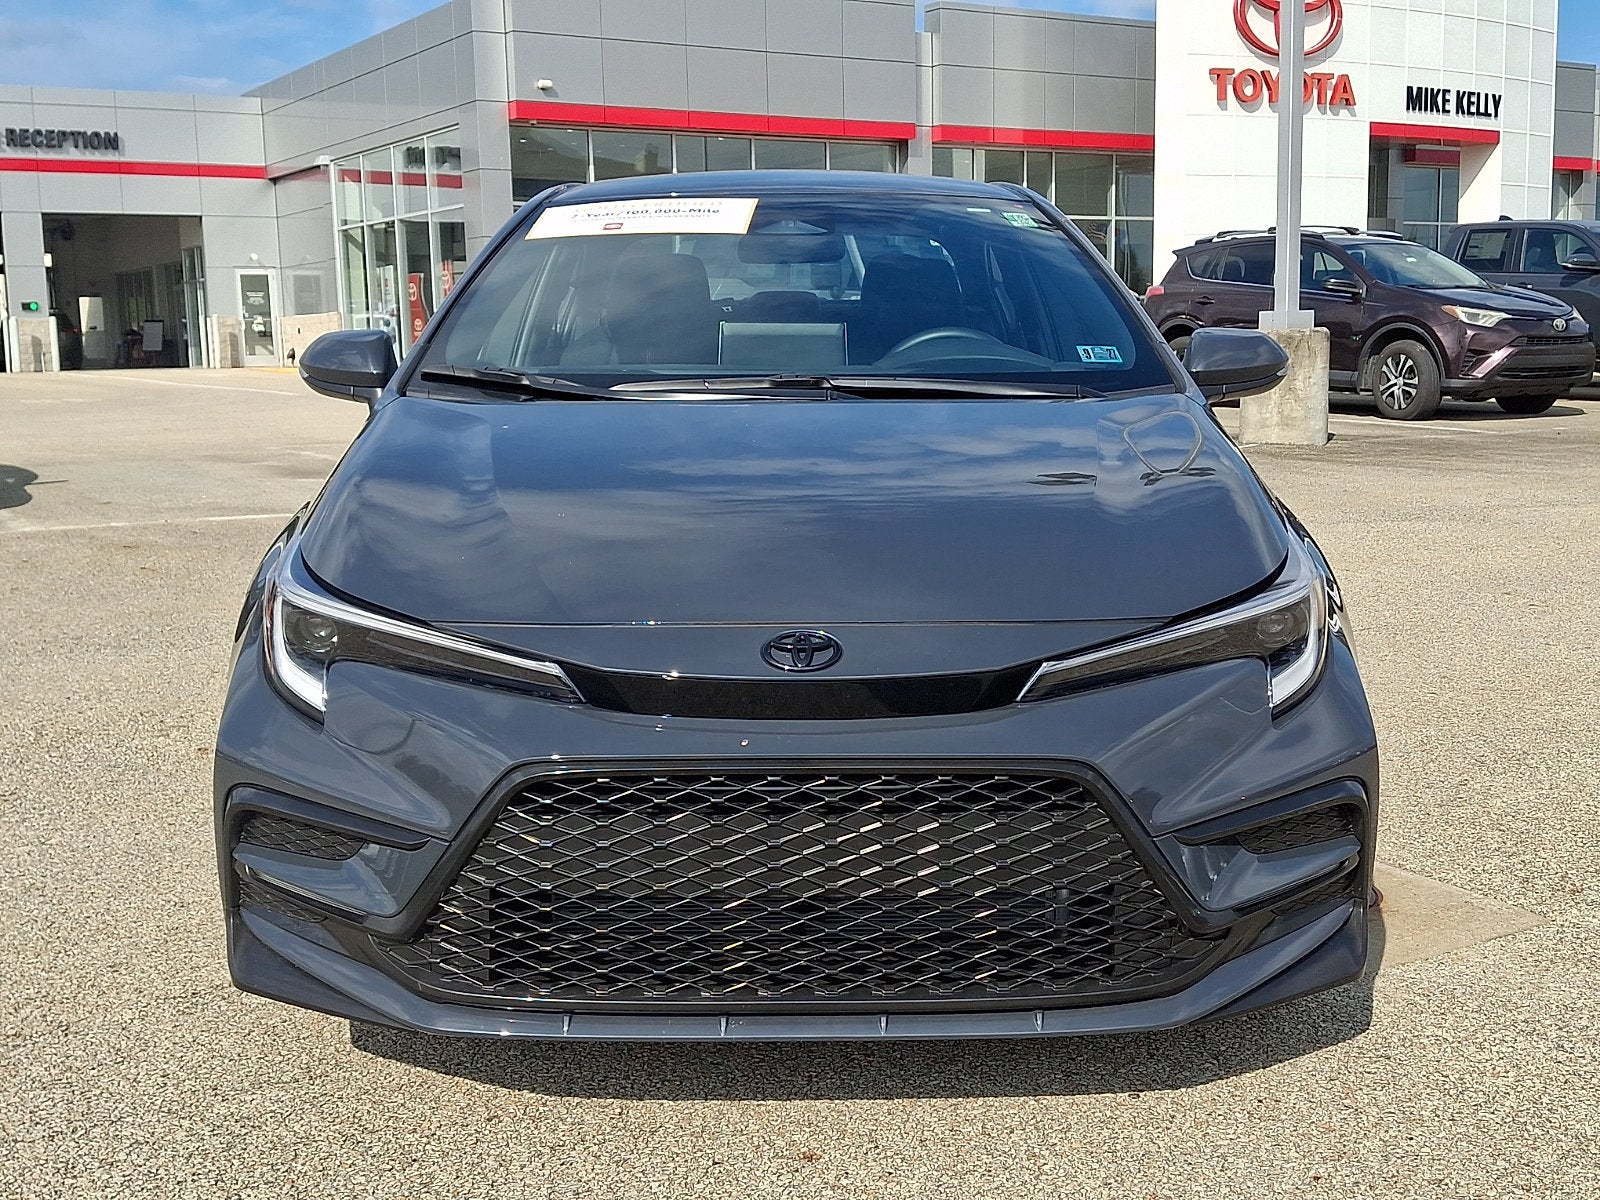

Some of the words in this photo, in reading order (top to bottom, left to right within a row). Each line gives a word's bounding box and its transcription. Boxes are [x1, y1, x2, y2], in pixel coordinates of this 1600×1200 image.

[1406, 85, 1451, 114] MIKE
[1456, 89, 1502, 119] KELLY
[5, 128, 119, 150] RECEPTION
